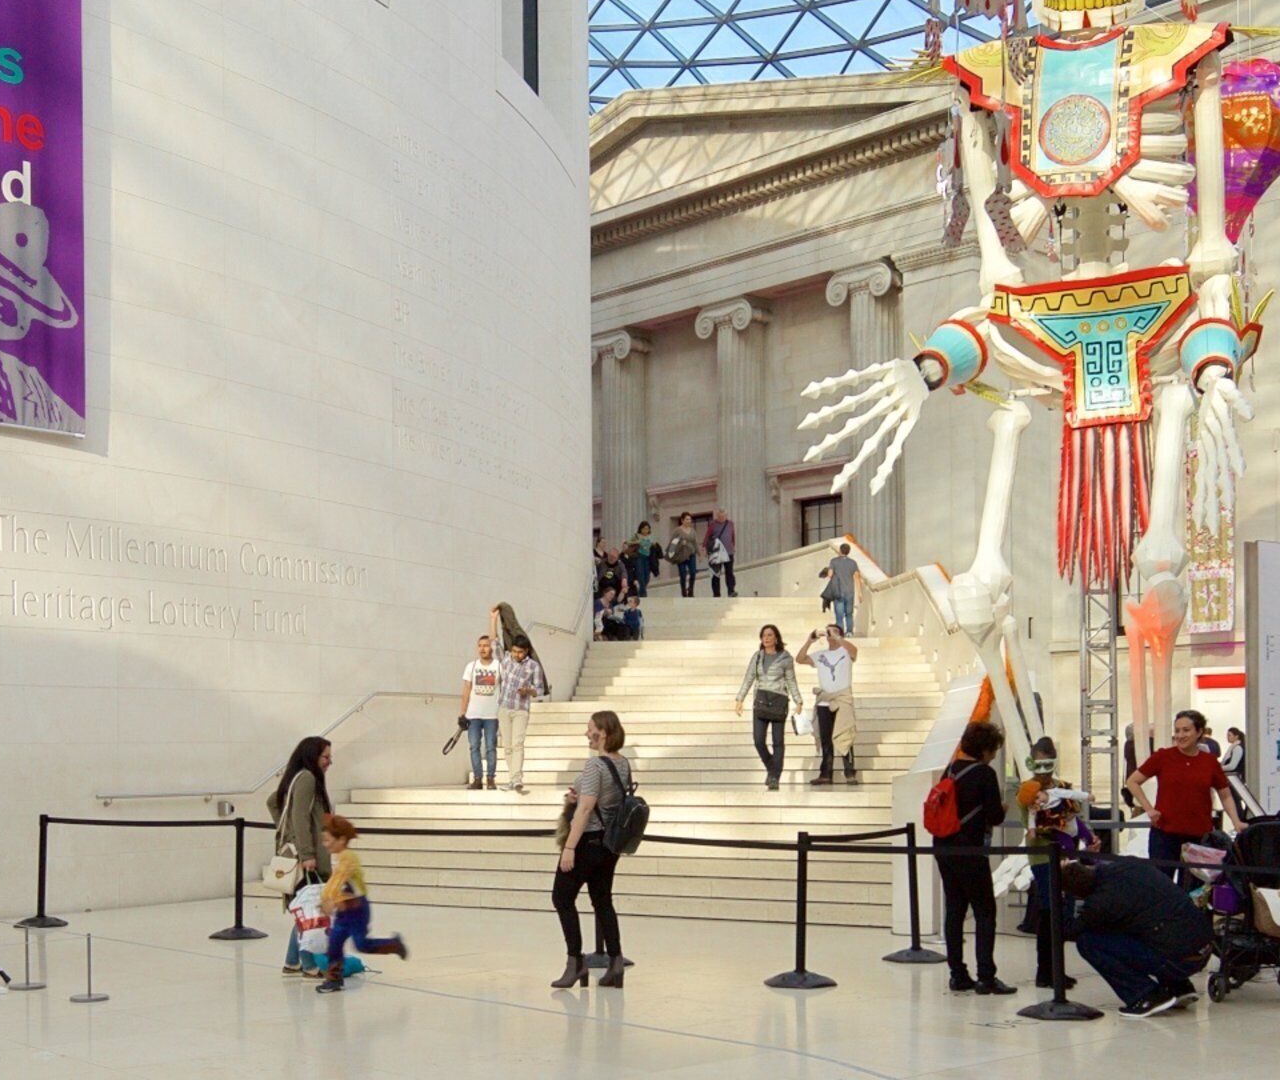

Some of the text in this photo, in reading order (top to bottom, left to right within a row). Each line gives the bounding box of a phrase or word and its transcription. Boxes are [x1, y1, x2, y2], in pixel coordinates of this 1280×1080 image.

[64, 521, 229, 574] Millennium
[239, 541, 370, 590] Commission
[148, 590, 241, 639] Lottery
[252, 599, 308, 637] Fund
